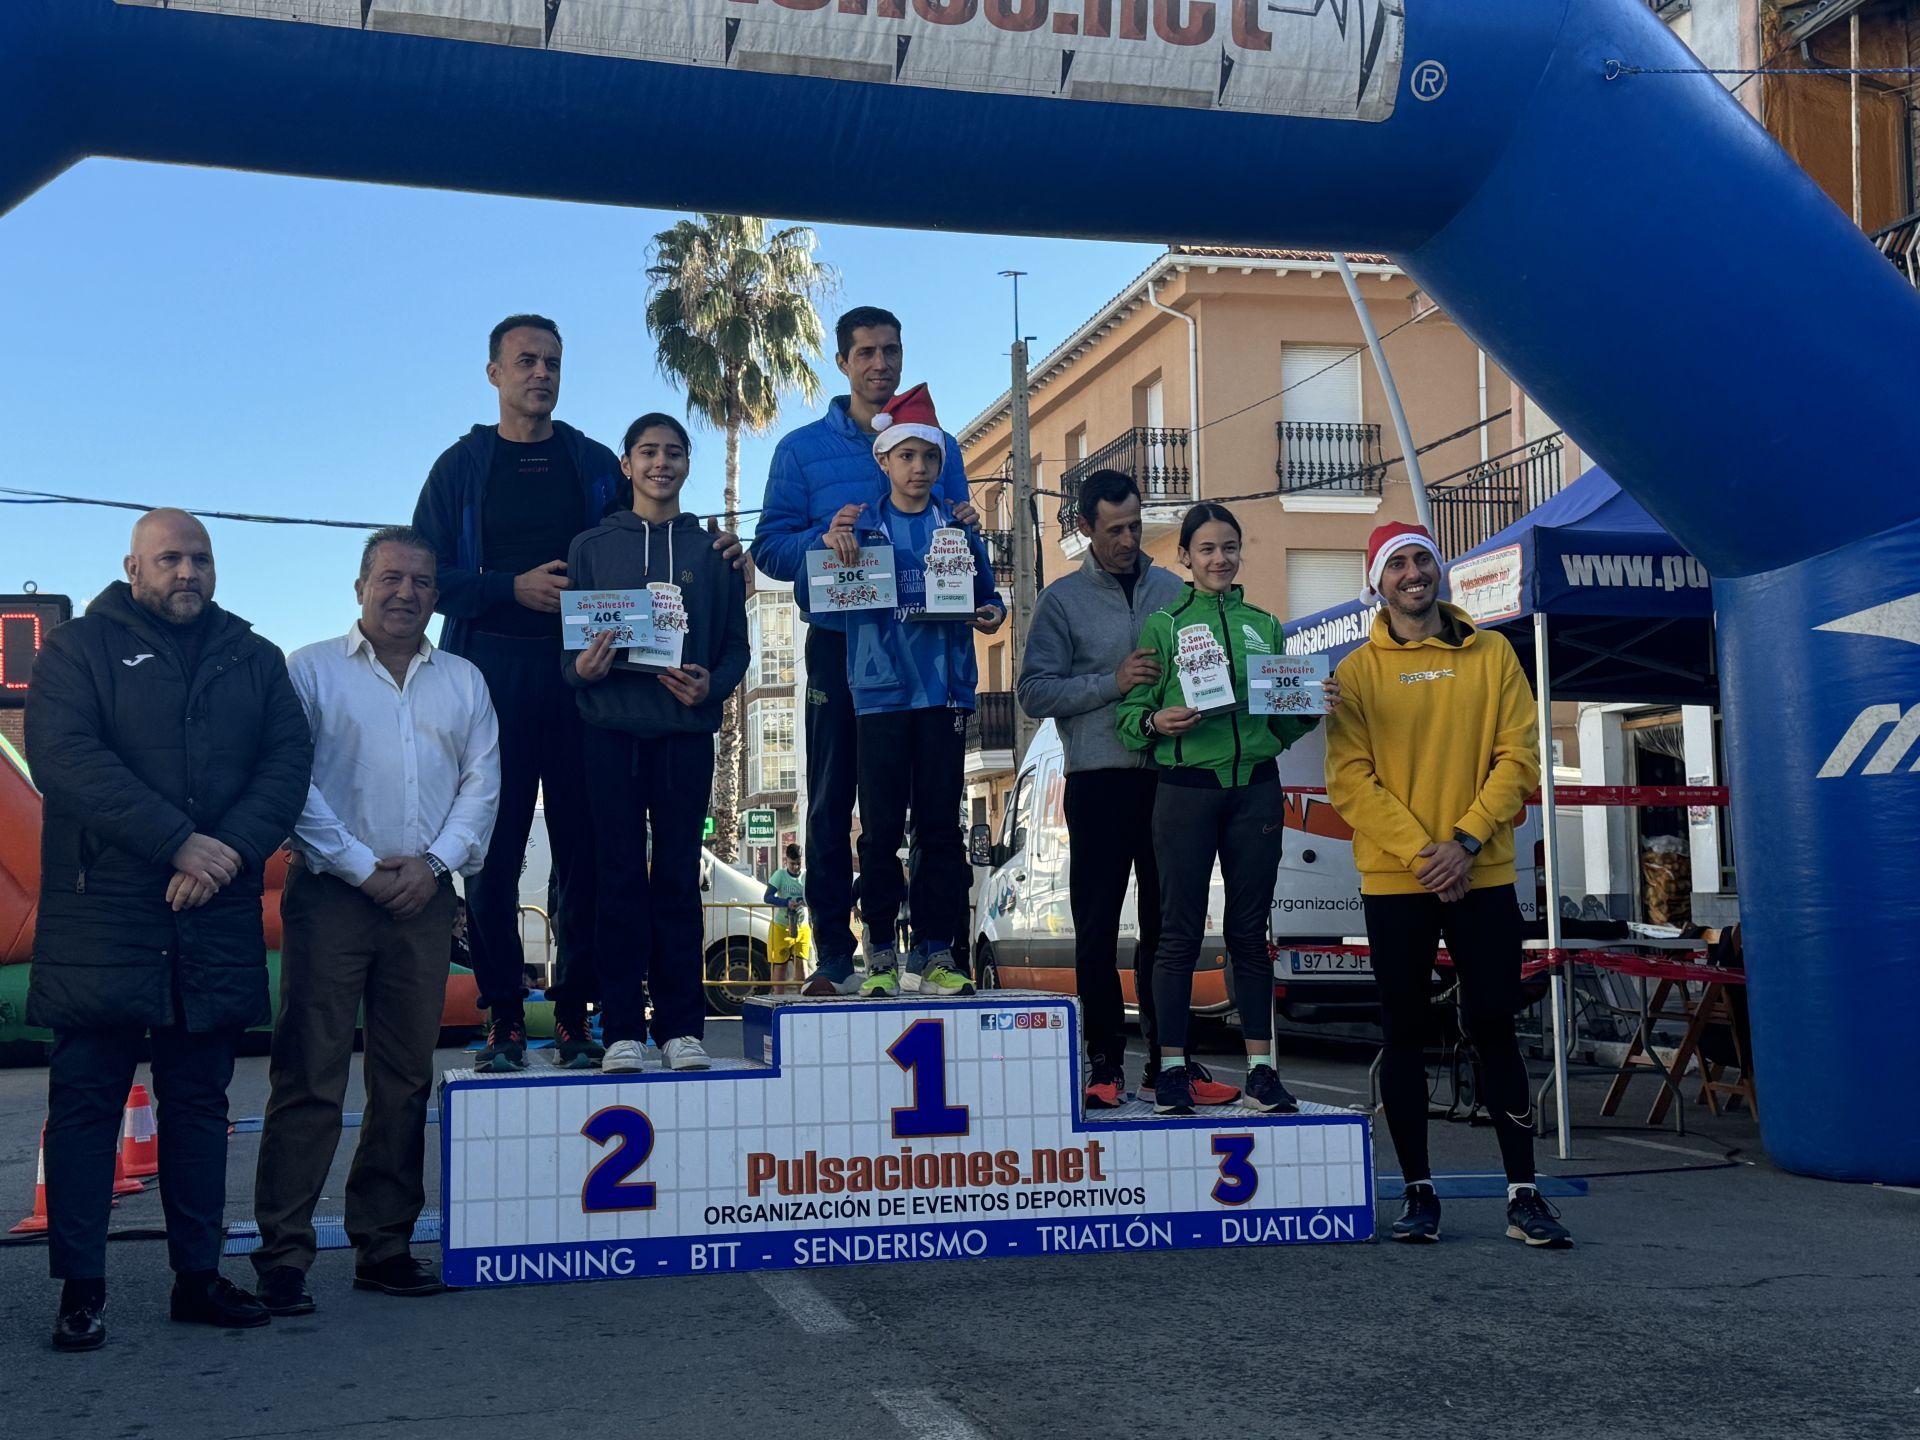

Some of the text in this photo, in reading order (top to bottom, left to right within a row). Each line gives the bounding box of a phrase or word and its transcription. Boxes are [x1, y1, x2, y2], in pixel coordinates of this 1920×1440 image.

[942, 537, 959, 546] San
[932, 545, 969, 555] Silvestre
[822, 560, 840, 570] San
[838, 569, 865, 583] 50€
[654, 591, 673, 601] San
[577, 600, 635, 610] San Silvestre
[651, 600, 682, 611] lvestre
[594, 611, 622, 623] 40€
[1187, 634, 1205, 644] San
[1180, 641, 1216, 654] Silvestre
[1261, 664, 1315, 674] San Silvestre
[1275, 676, 1300, 688] 30€
[751, 813, 772, 823] ÓPTICA
[749, 826, 774, 835] ESTEBAN
[1304, 953, 1373, 969] 9712 JF
[885, 1018, 970, 1139] 1
[580, 1105, 656, 1213] 2
[747, 1139, 1107, 1198] Pulsaciones.net
[1210, 1132, 1259, 1207] 3
[704, 1186, 1146, 1226] ORGANIZACIÓN DE EVENTOS DEPORTIVOS
[475, 1246, 636, 1284] RUNNING
[691, 1241, 742, 1270] BTT
[793, 1228, 988, 1267] SENDERISMO
[1036, 1214, 1173, 1252] TRIATLÓN
[1221, 1209, 1355, 1244] DUATLÓN
